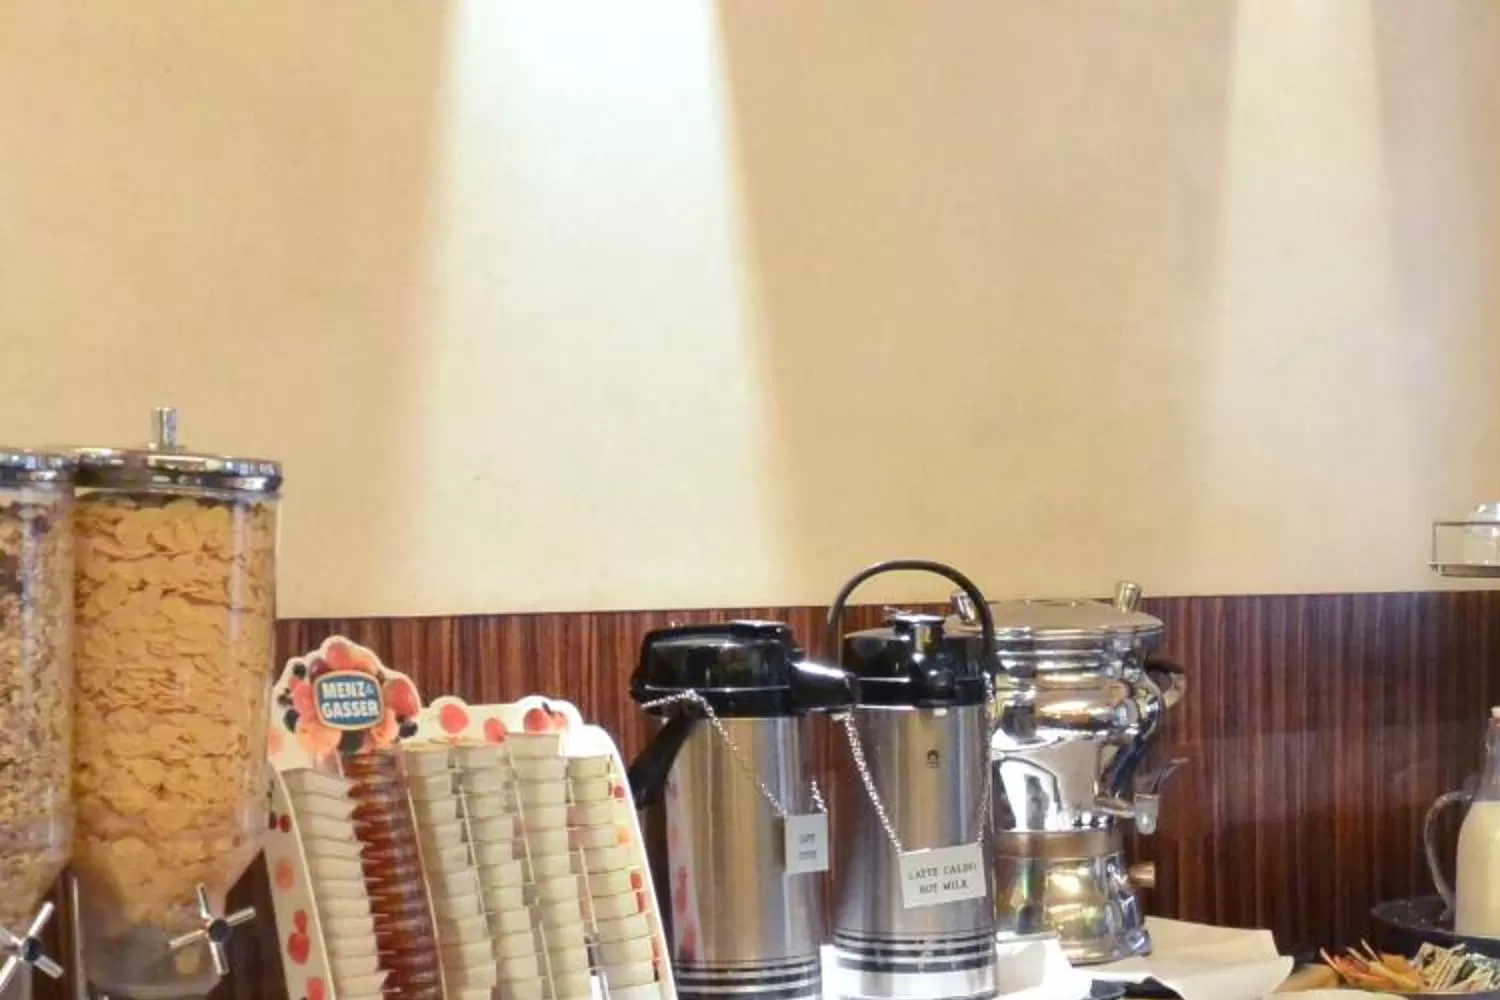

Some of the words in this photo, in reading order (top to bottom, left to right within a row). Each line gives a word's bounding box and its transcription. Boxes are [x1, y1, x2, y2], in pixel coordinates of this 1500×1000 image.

[322, 681, 365, 698] MENZ
[321, 700, 379, 719] GASSER
[943, 879, 968, 891] MILK
